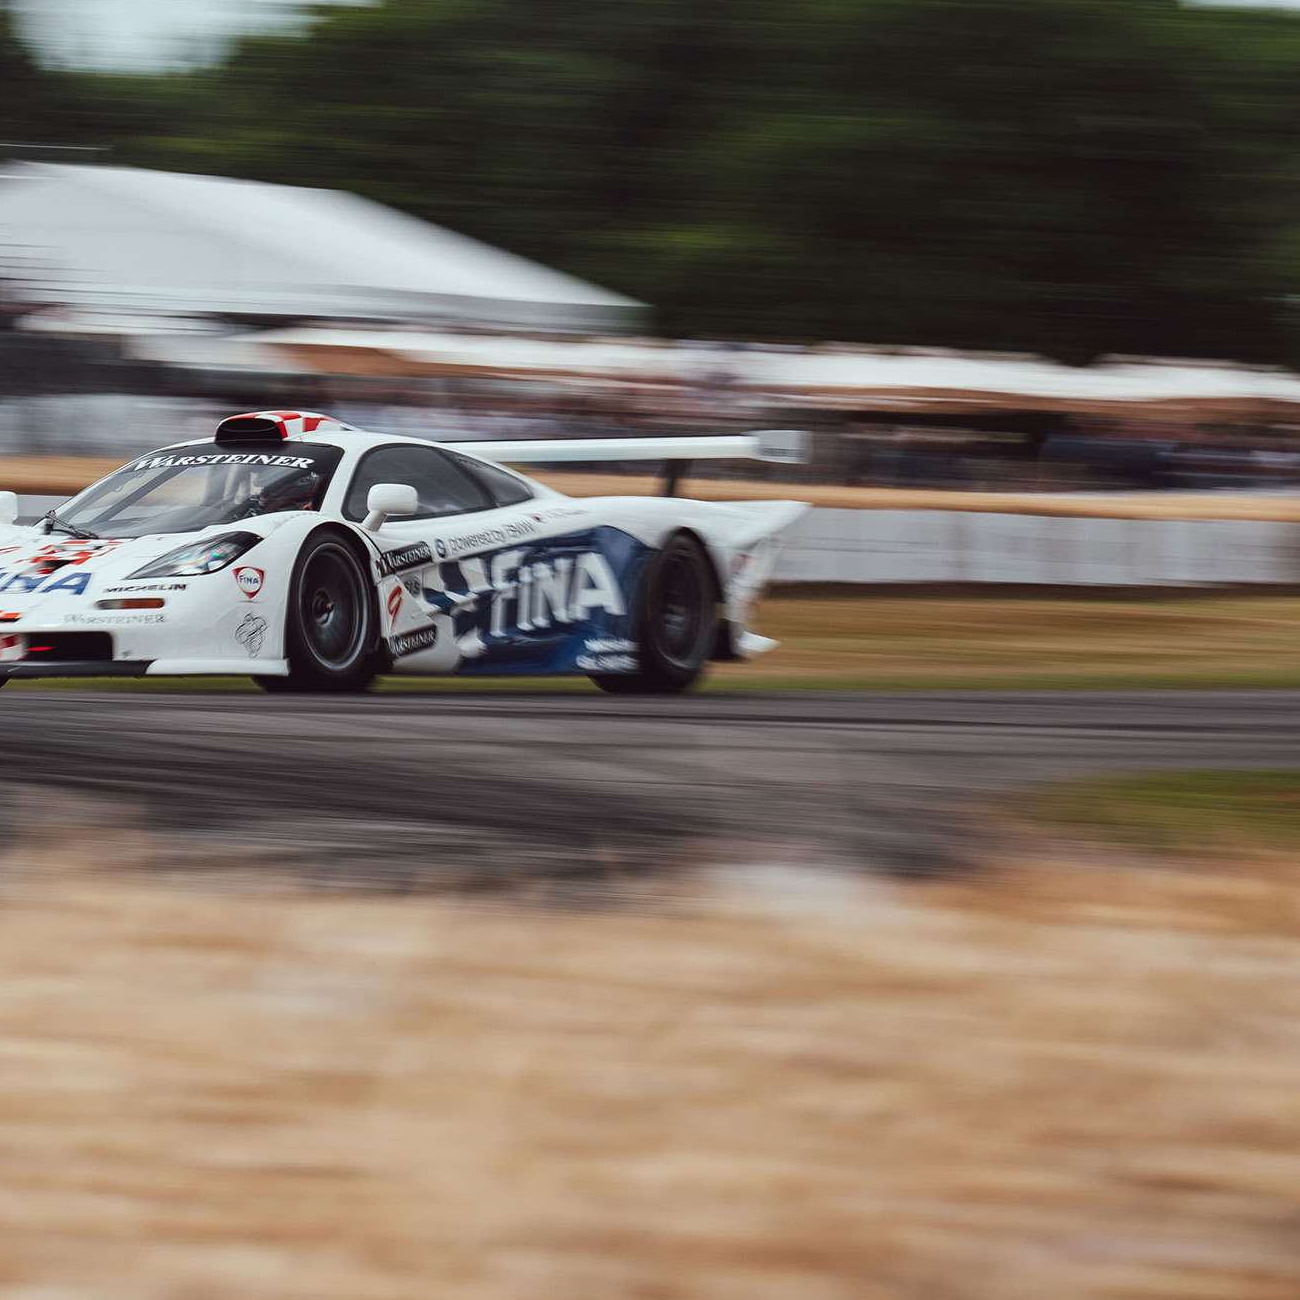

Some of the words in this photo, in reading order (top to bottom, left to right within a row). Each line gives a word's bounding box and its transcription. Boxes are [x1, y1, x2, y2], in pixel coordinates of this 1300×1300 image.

[134, 454, 315, 471] WARSTEINER
[239, 574, 259, 584] FINA
[104, 583, 188, 593] MICHELIN
[490, 551, 627, 637] FINA
